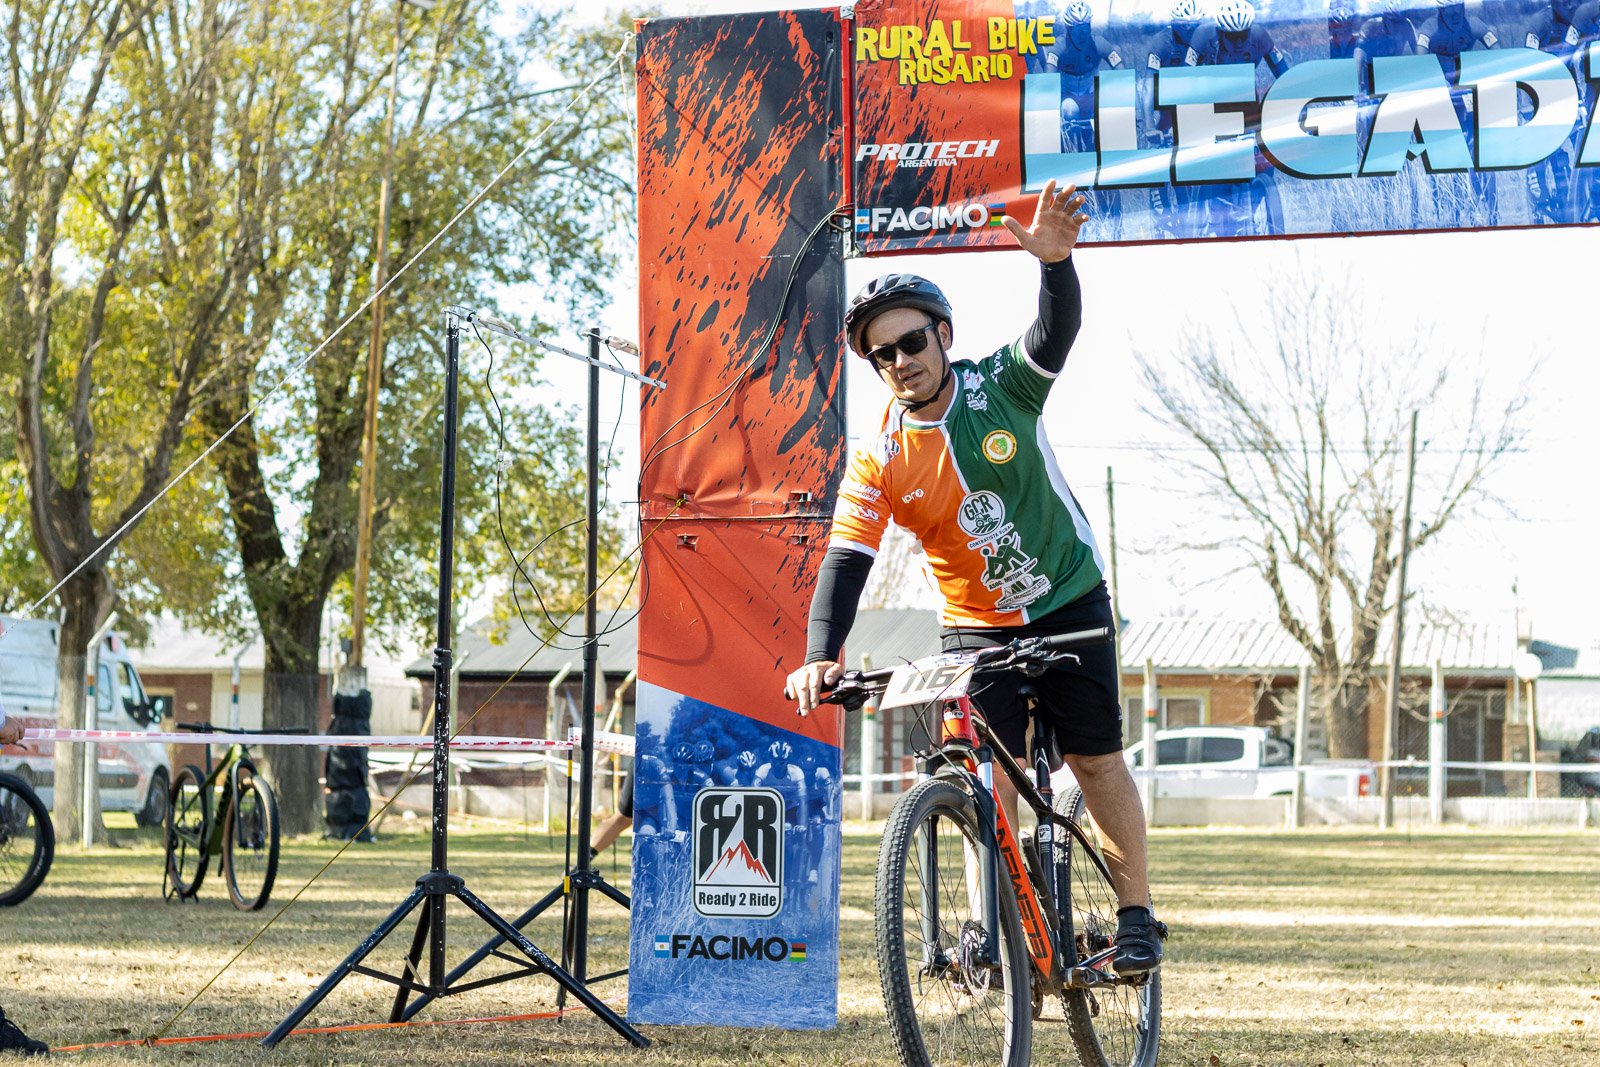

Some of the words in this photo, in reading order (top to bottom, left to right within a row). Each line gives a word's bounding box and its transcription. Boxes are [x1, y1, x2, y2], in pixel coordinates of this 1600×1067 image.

[856, 19, 971, 62] RURAL
[987, 15, 1056, 56] BIKE
[898, 53, 1014, 86] ROSARIO
[1019, 40, 1600, 194] LLEGAD
[855, 139, 1001, 162] PROTECH
[896, 158, 958, 168] ARGENTINA
[871, 203, 989, 233] FACIMO
[963, 494, 994, 521] GCR
[969, 532, 999, 549] CONTRATISTA
[900, 665, 961, 694] 116
[698, 891, 737, 907] Ready
[739, 892, 746, 907] 2
[749, 892, 777, 907] Ride
[671, 934, 788, 963] FACIMO
